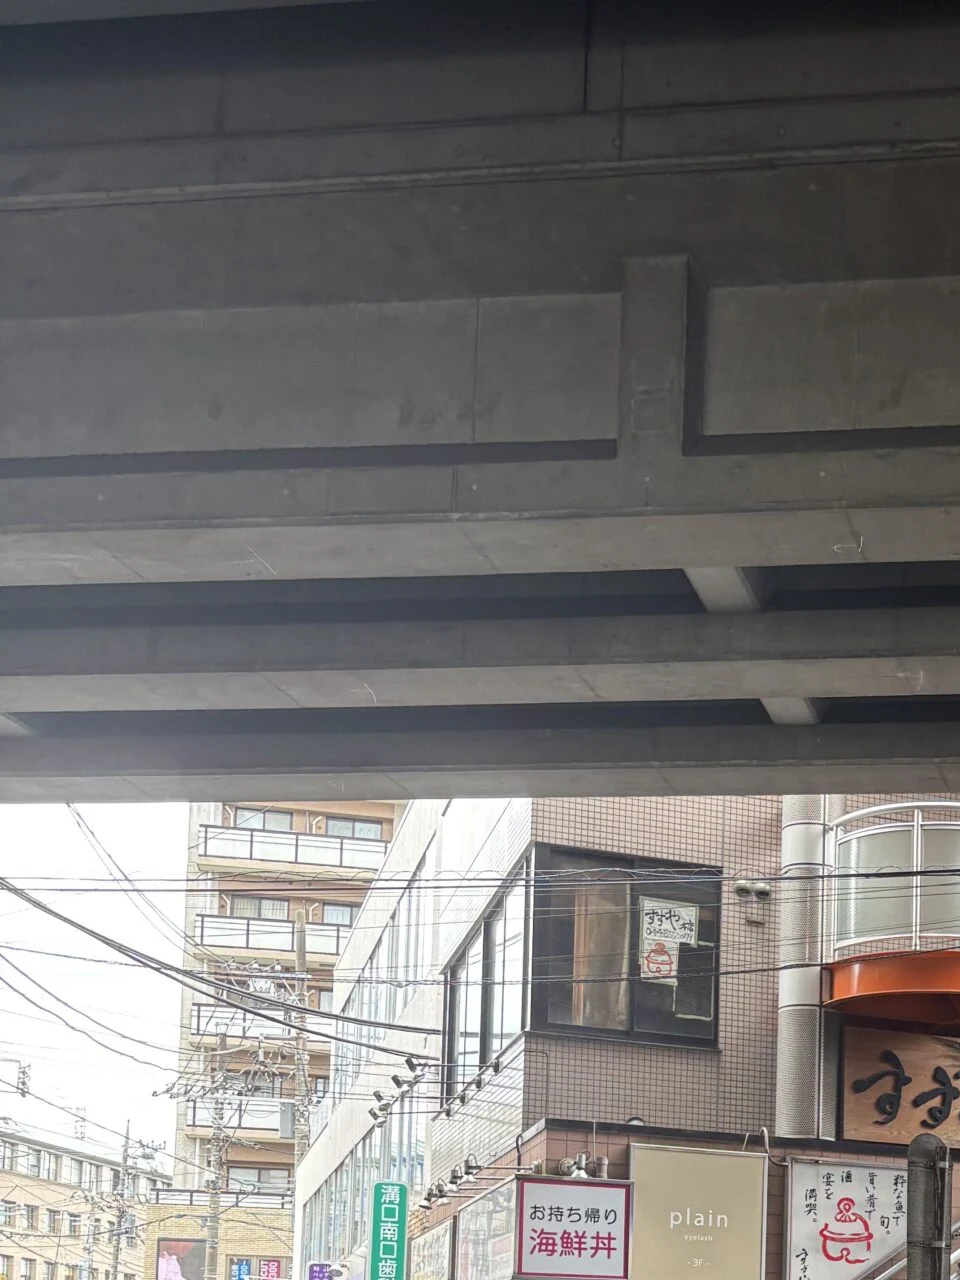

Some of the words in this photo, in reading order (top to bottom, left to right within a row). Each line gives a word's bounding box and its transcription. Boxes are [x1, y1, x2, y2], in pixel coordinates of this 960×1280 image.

[529, 1204, 617, 1225] お持ち帰り
[670, 1207, 728, 1229] plain
[529, 1228, 617, 1259] 海鮮丼
[260, 1260, 268, 1276] CUT
